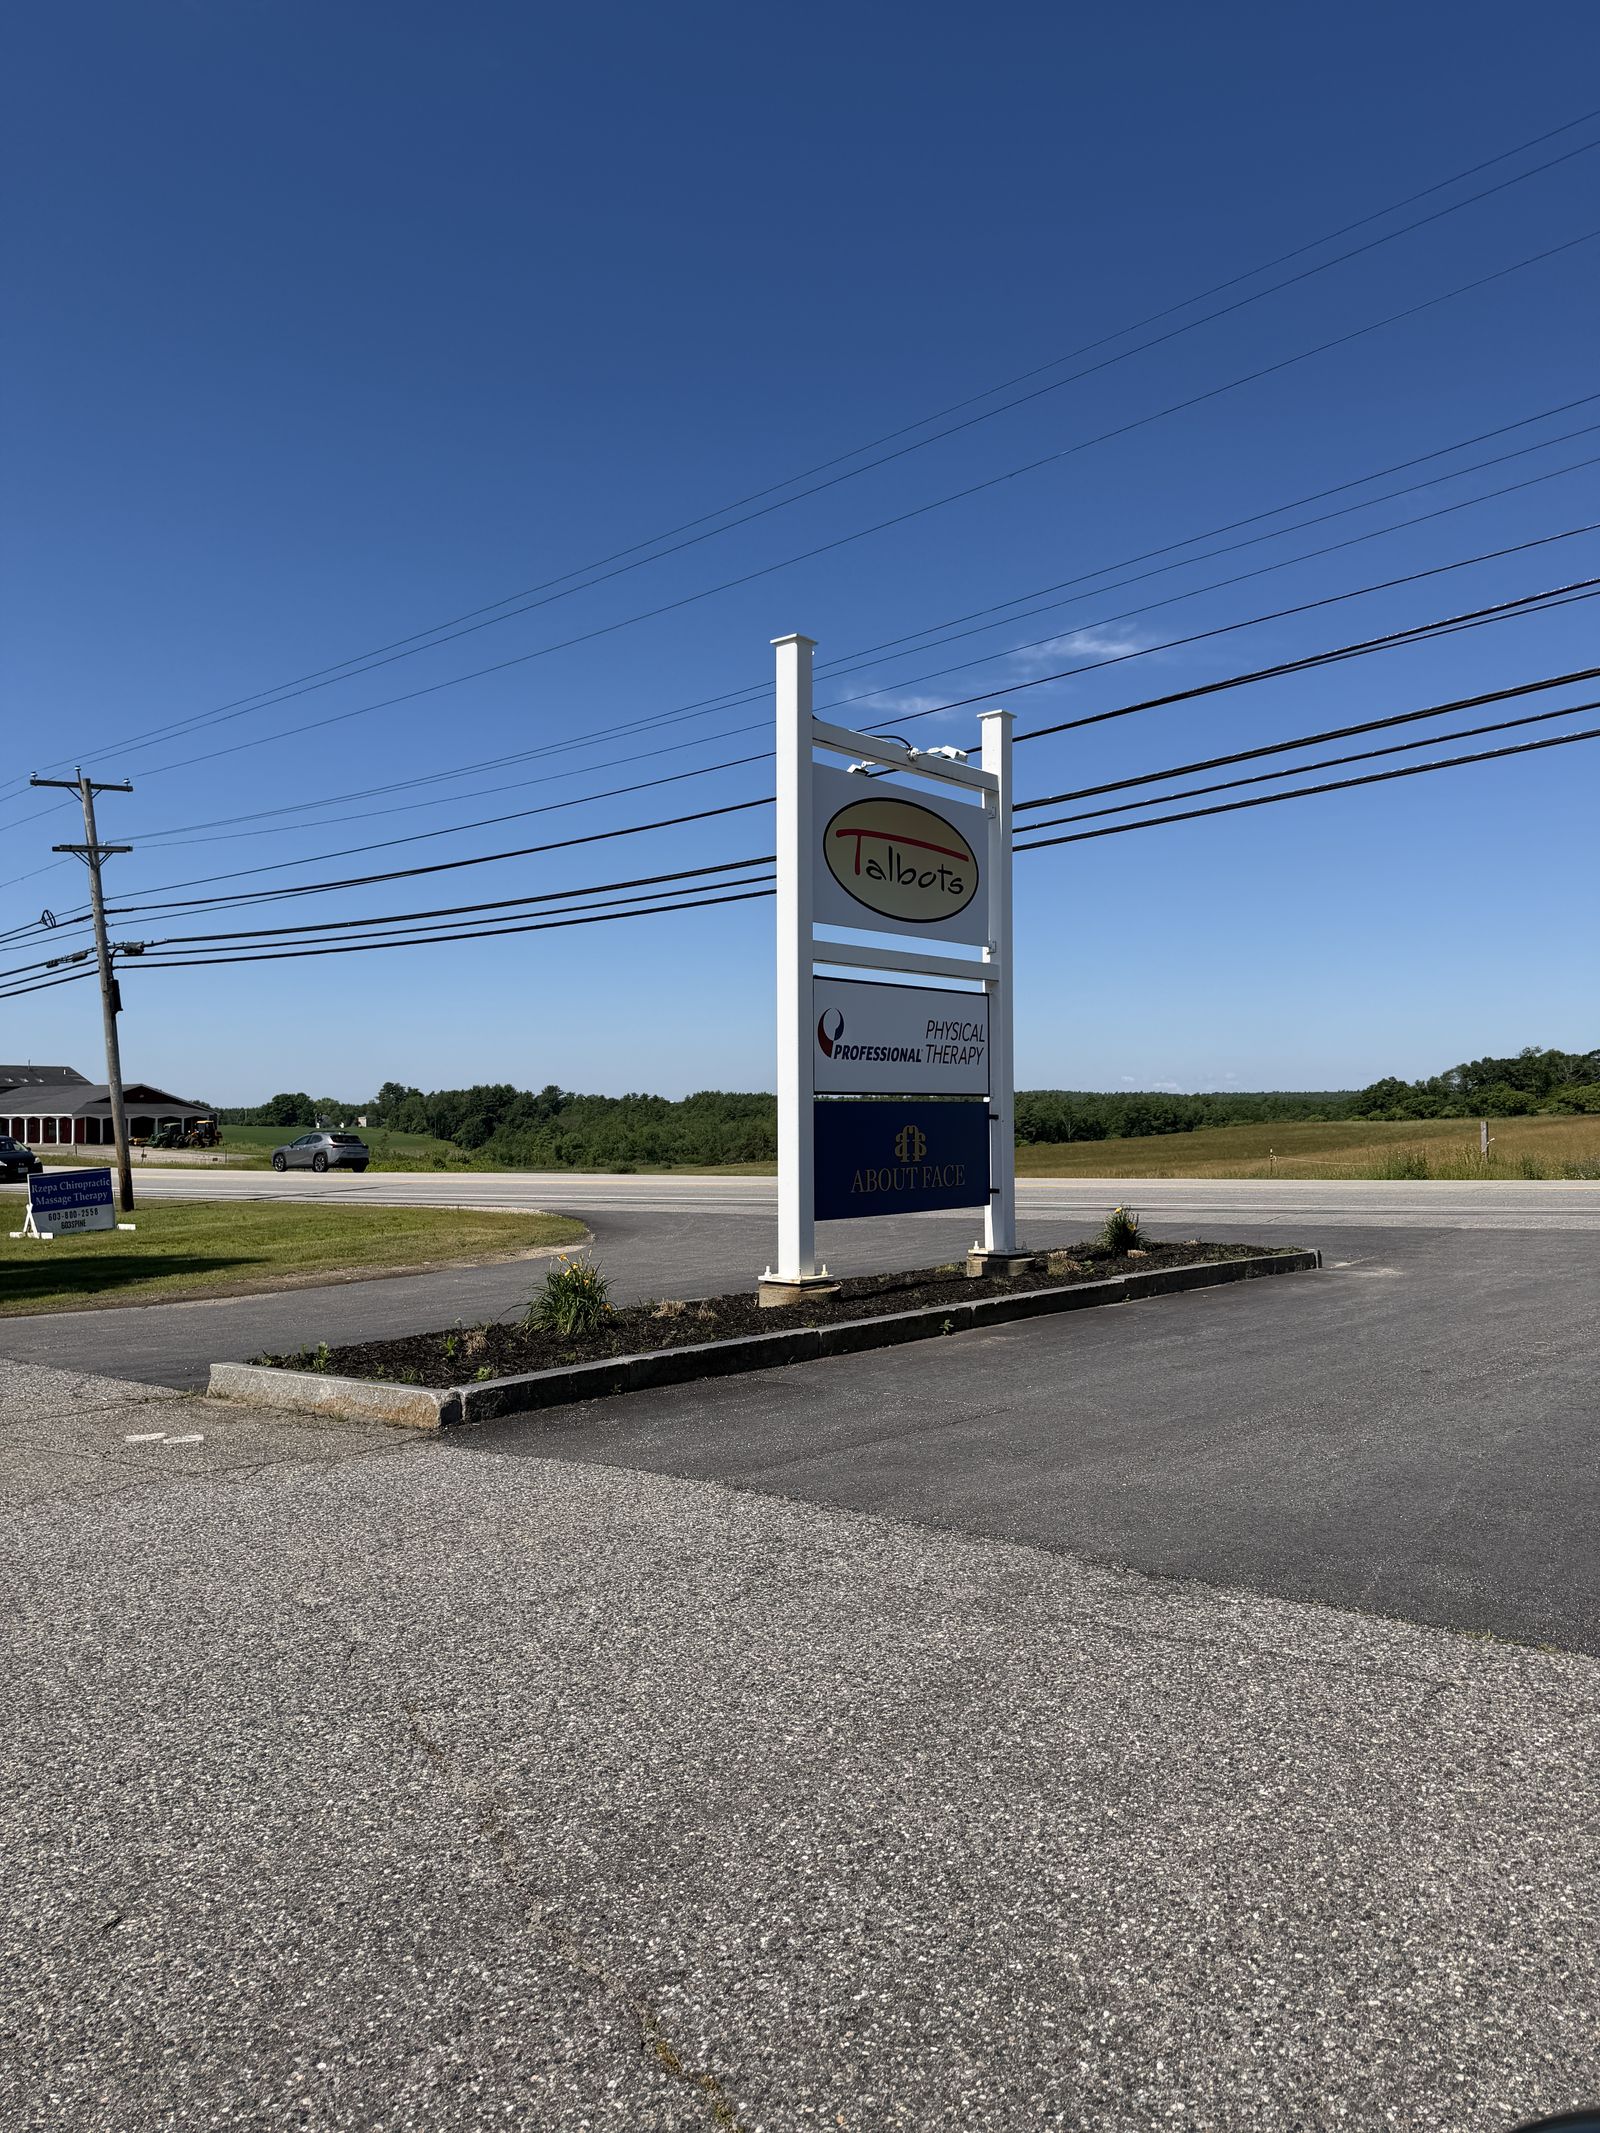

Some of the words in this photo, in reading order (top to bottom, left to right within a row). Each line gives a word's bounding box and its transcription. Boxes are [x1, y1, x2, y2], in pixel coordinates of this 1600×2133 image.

[835, 828, 970, 895] Talbots
[925, 1020, 985, 1043] PHYSICAL
[833, 1044, 922, 1063] PROFESSIONAL
[925, 1044, 984, 1066] THERAPY
[31, 1184, 58, 1194] Rzepa
[59, 1178, 110, 1191] Chiropractic
[850, 1167, 918, 1193] ABOUT
[923, 1164, 966, 1188] FACE
[35, 1195, 72, 1206] Massage
[73, 1191, 108, 1202] Therapy
